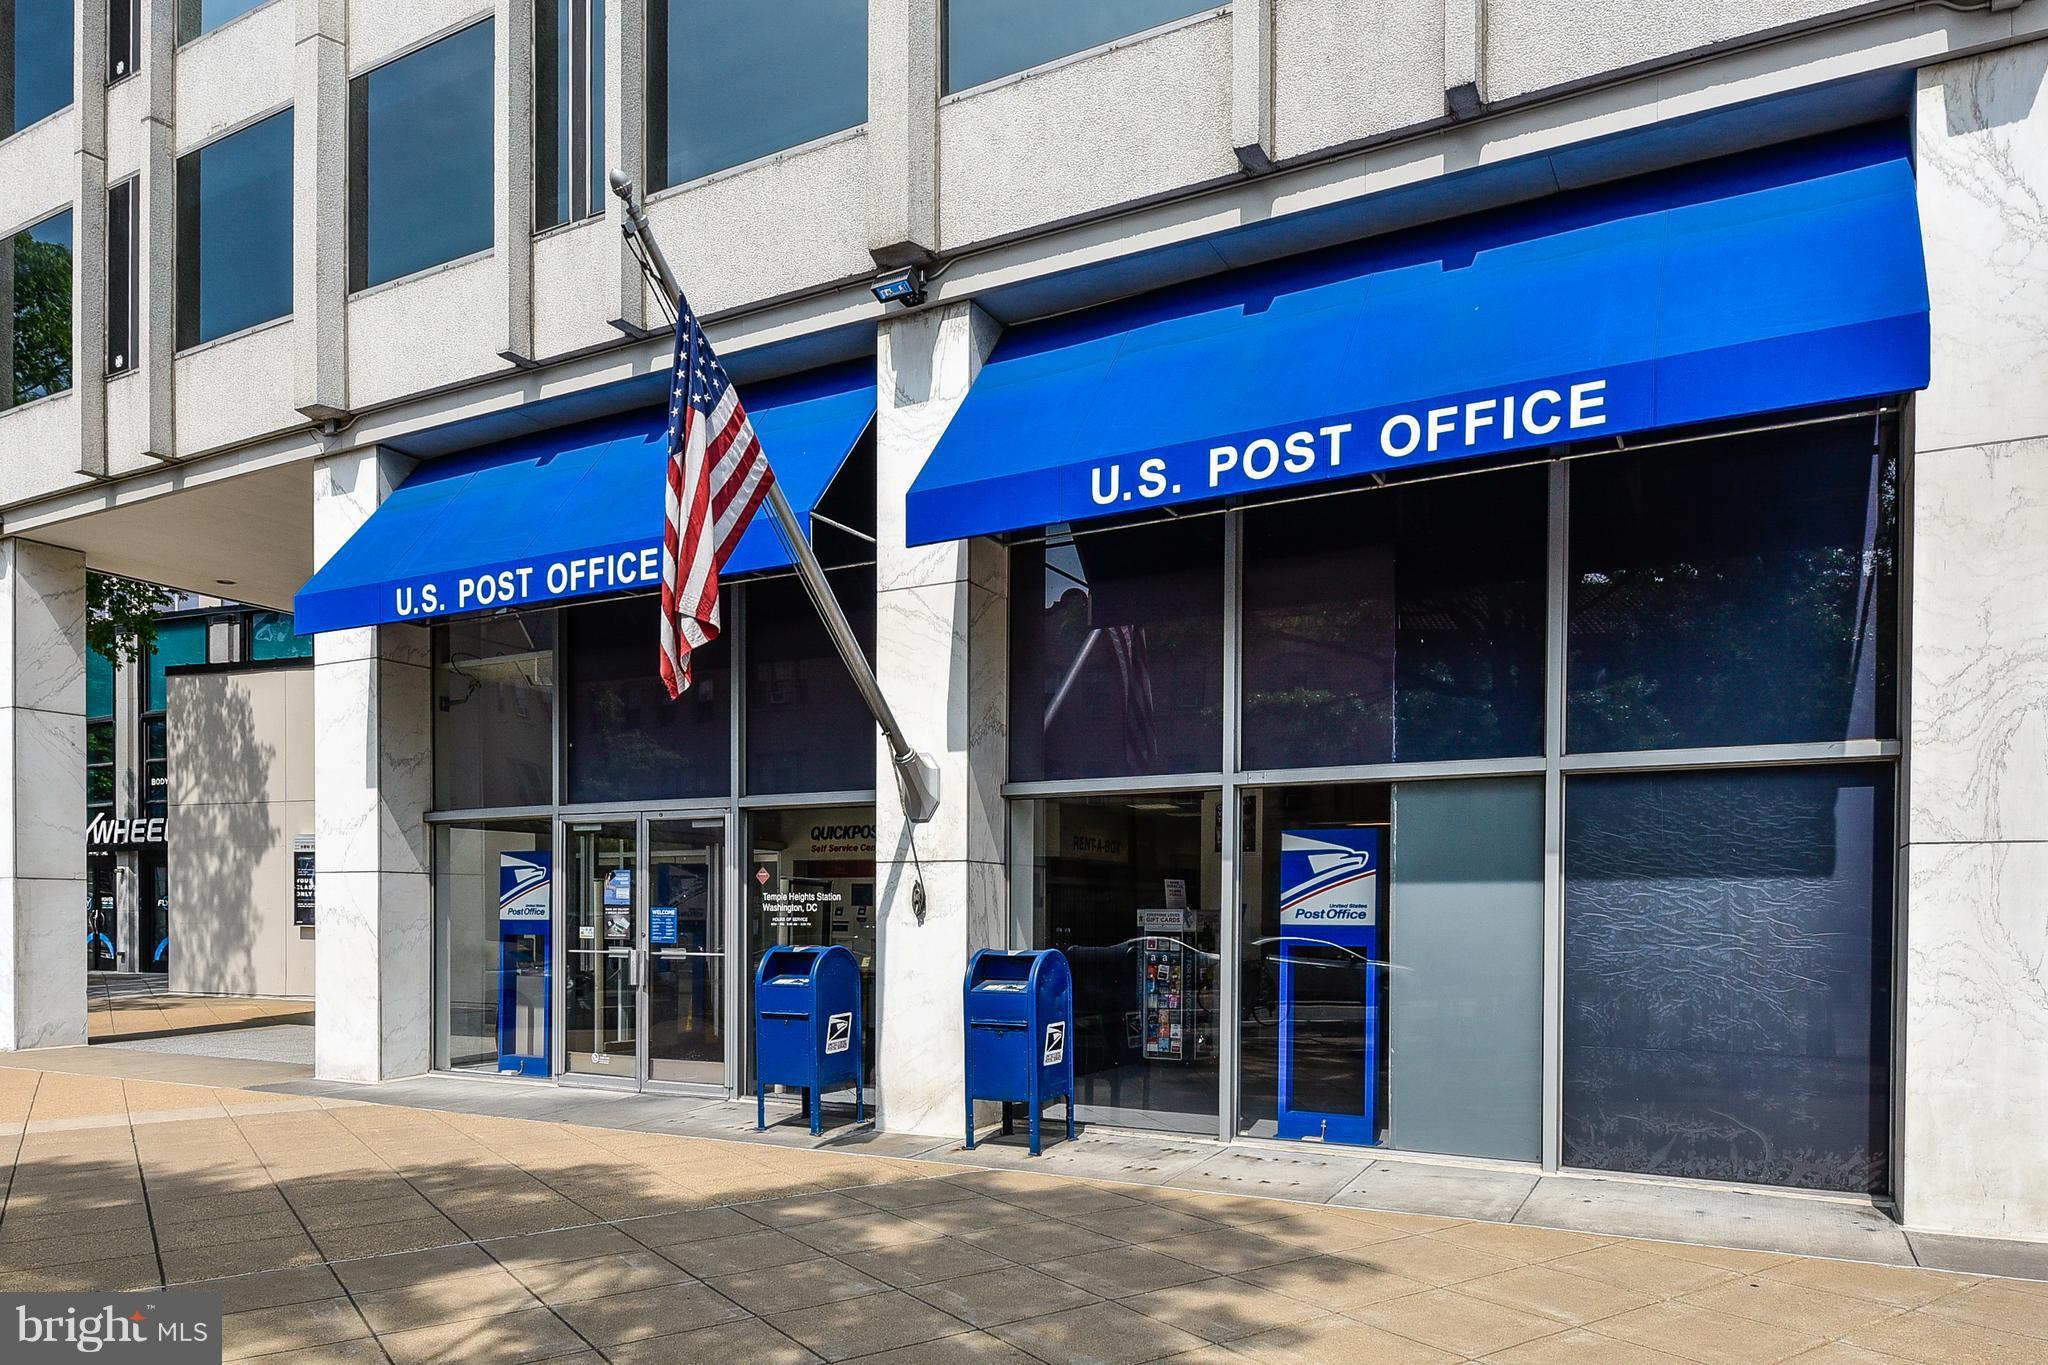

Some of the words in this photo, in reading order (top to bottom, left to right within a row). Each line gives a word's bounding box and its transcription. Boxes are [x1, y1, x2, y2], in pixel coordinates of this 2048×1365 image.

[1091, 458, 1181, 505] U.S.
[1209, 423, 1352, 487] POST
[1380, 379, 1607, 458] OFFICE
[396, 584, 445, 616] U.S.
[459, 567, 533, 608] POST
[546, 548, 659, 594] OFFICE
[811, 844, 827, 853] Self
[829, 844, 858, 852] Service
[762, 892, 788, 902] Temple
[789, 892, 815, 902] Heights
[816, 892, 842, 901] Station
[762, 903, 805, 913] Washington,
[806, 903, 818, 912] DC
[1295, 908, 1326, 919] Post
[1327, 908, 1367, 919] Office
